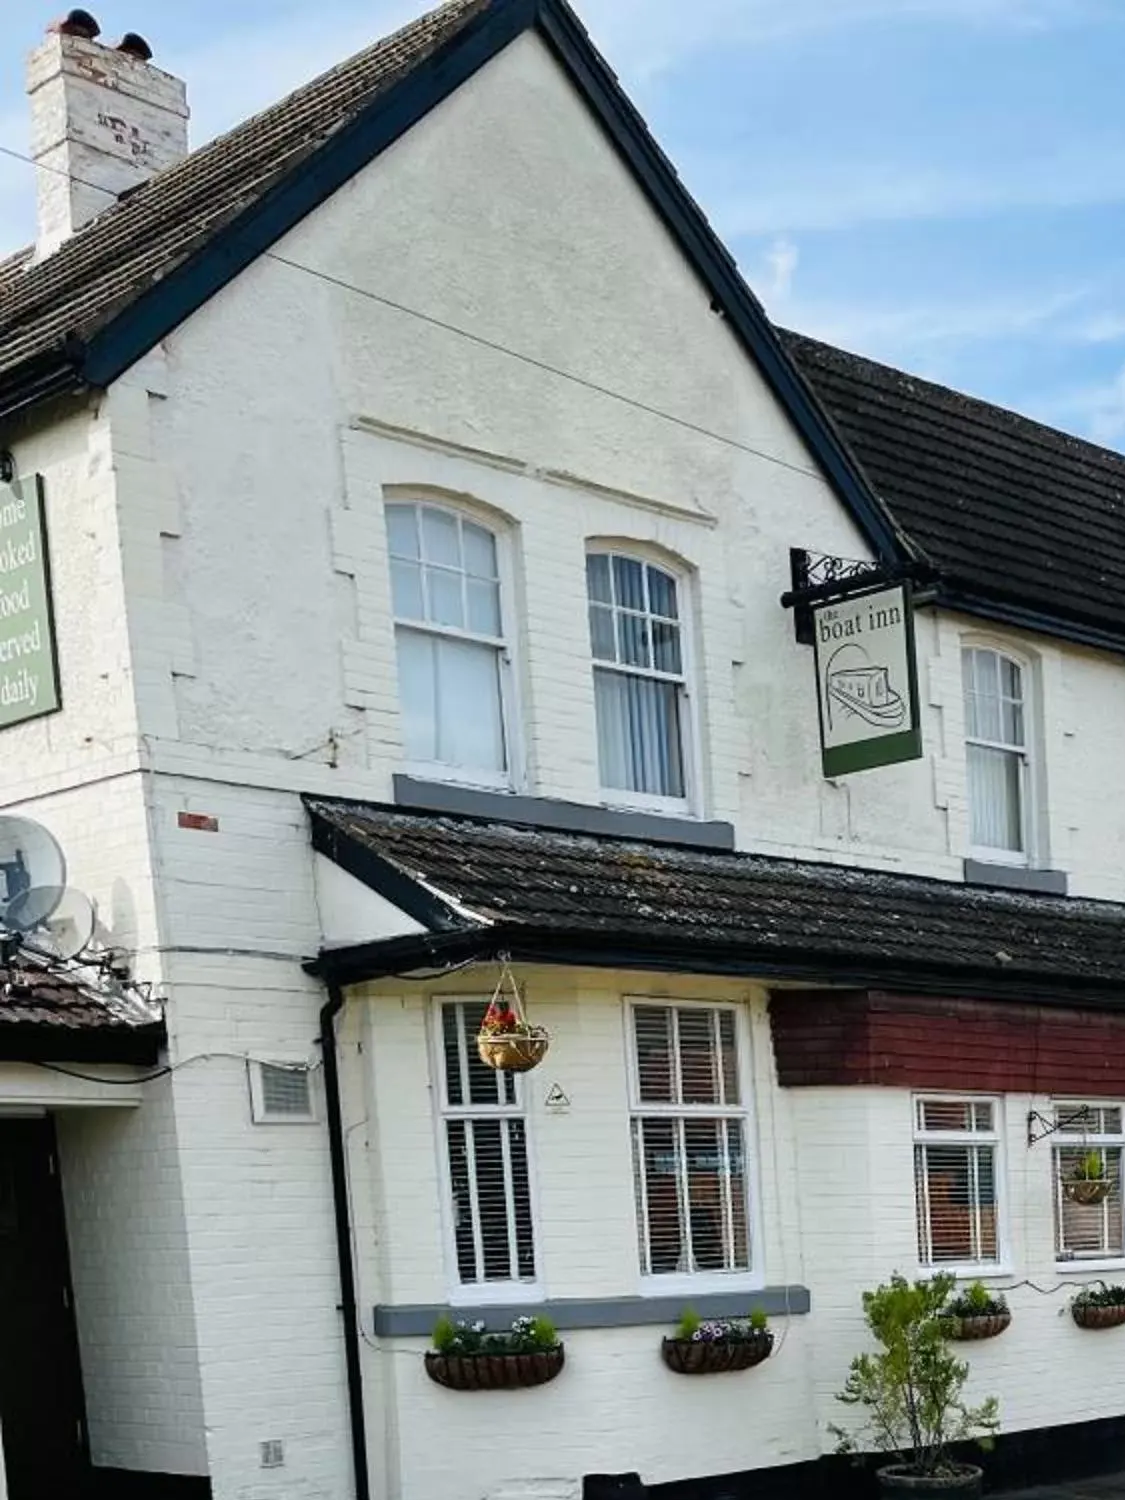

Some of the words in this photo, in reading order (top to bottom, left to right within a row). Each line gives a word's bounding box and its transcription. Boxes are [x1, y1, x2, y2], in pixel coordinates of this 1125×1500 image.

[819, 612, 862, 643] boat
[868, 604, 900, 631] inn
[2, 667, 39, 706] daily
